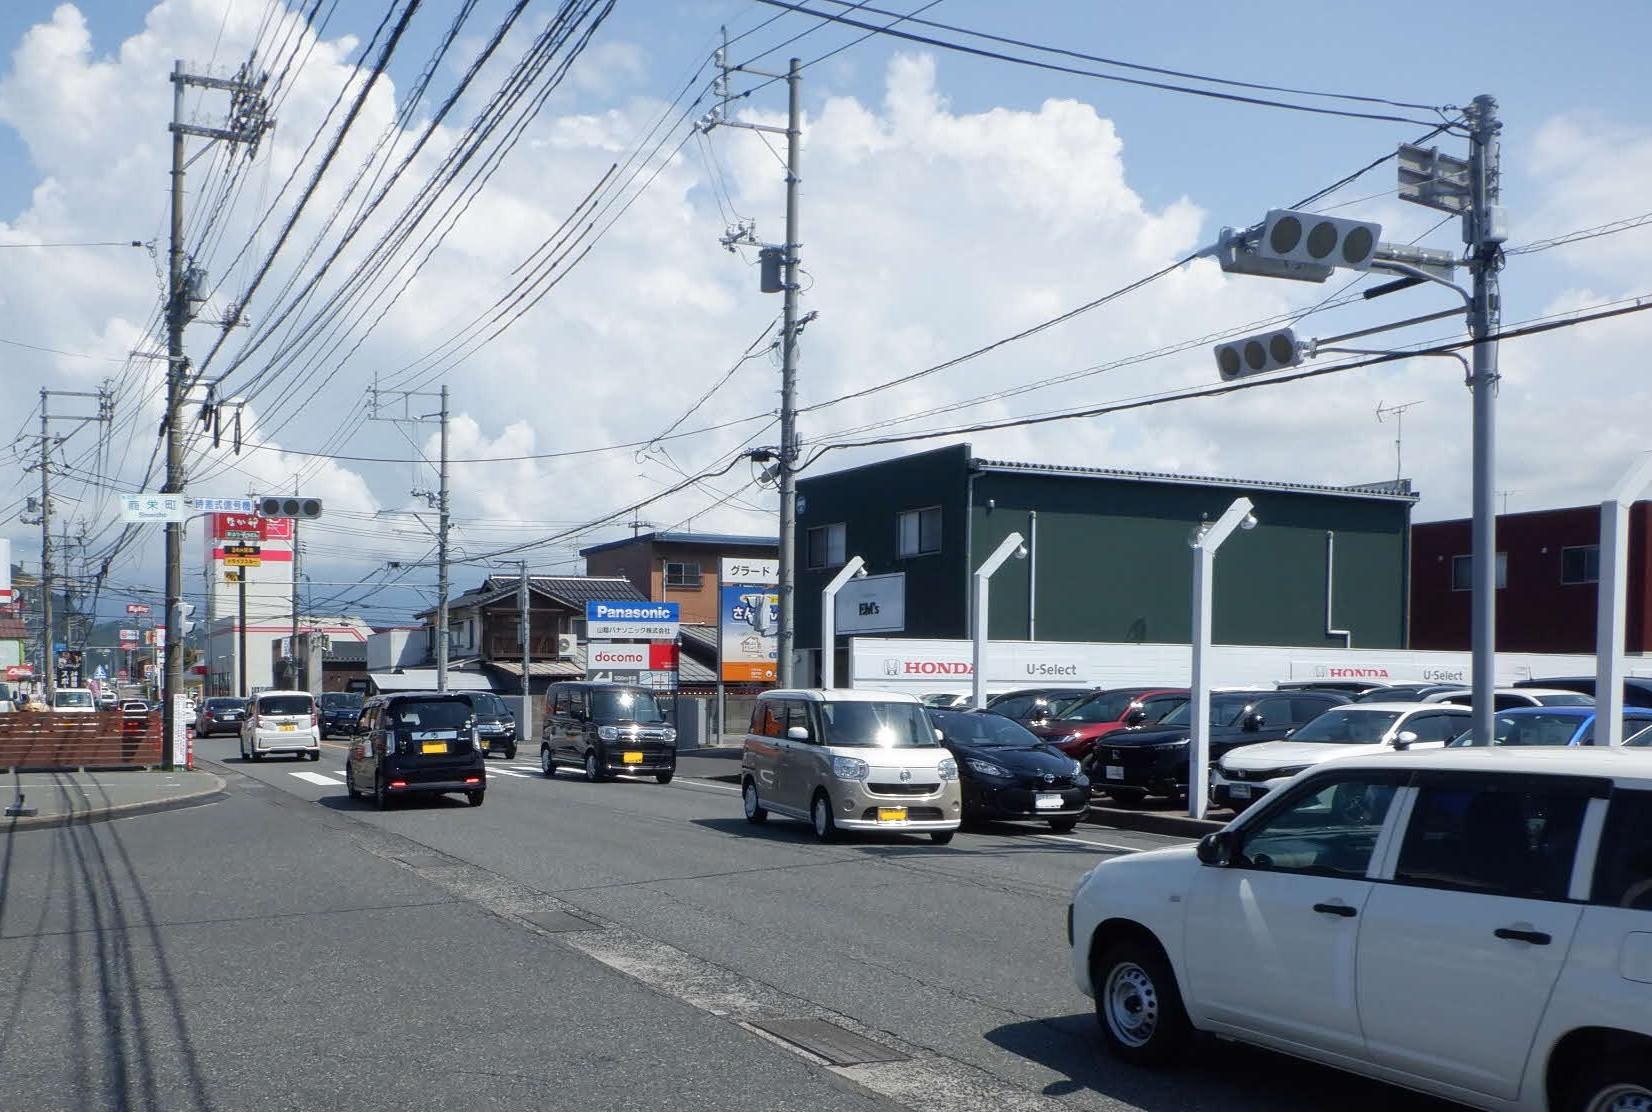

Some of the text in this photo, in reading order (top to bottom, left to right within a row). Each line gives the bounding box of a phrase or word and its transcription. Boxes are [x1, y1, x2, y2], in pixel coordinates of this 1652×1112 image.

[195, 500, 251, 511] 時差式信号機
[730, 565, 770, 577] グラード
[596, 605, 671, 619] Panasonic
[595, 651, 643, 662] docomo
[1026, 663, 1077, 675] U-Select
[1423, 669, 1463, 681] U-Select
